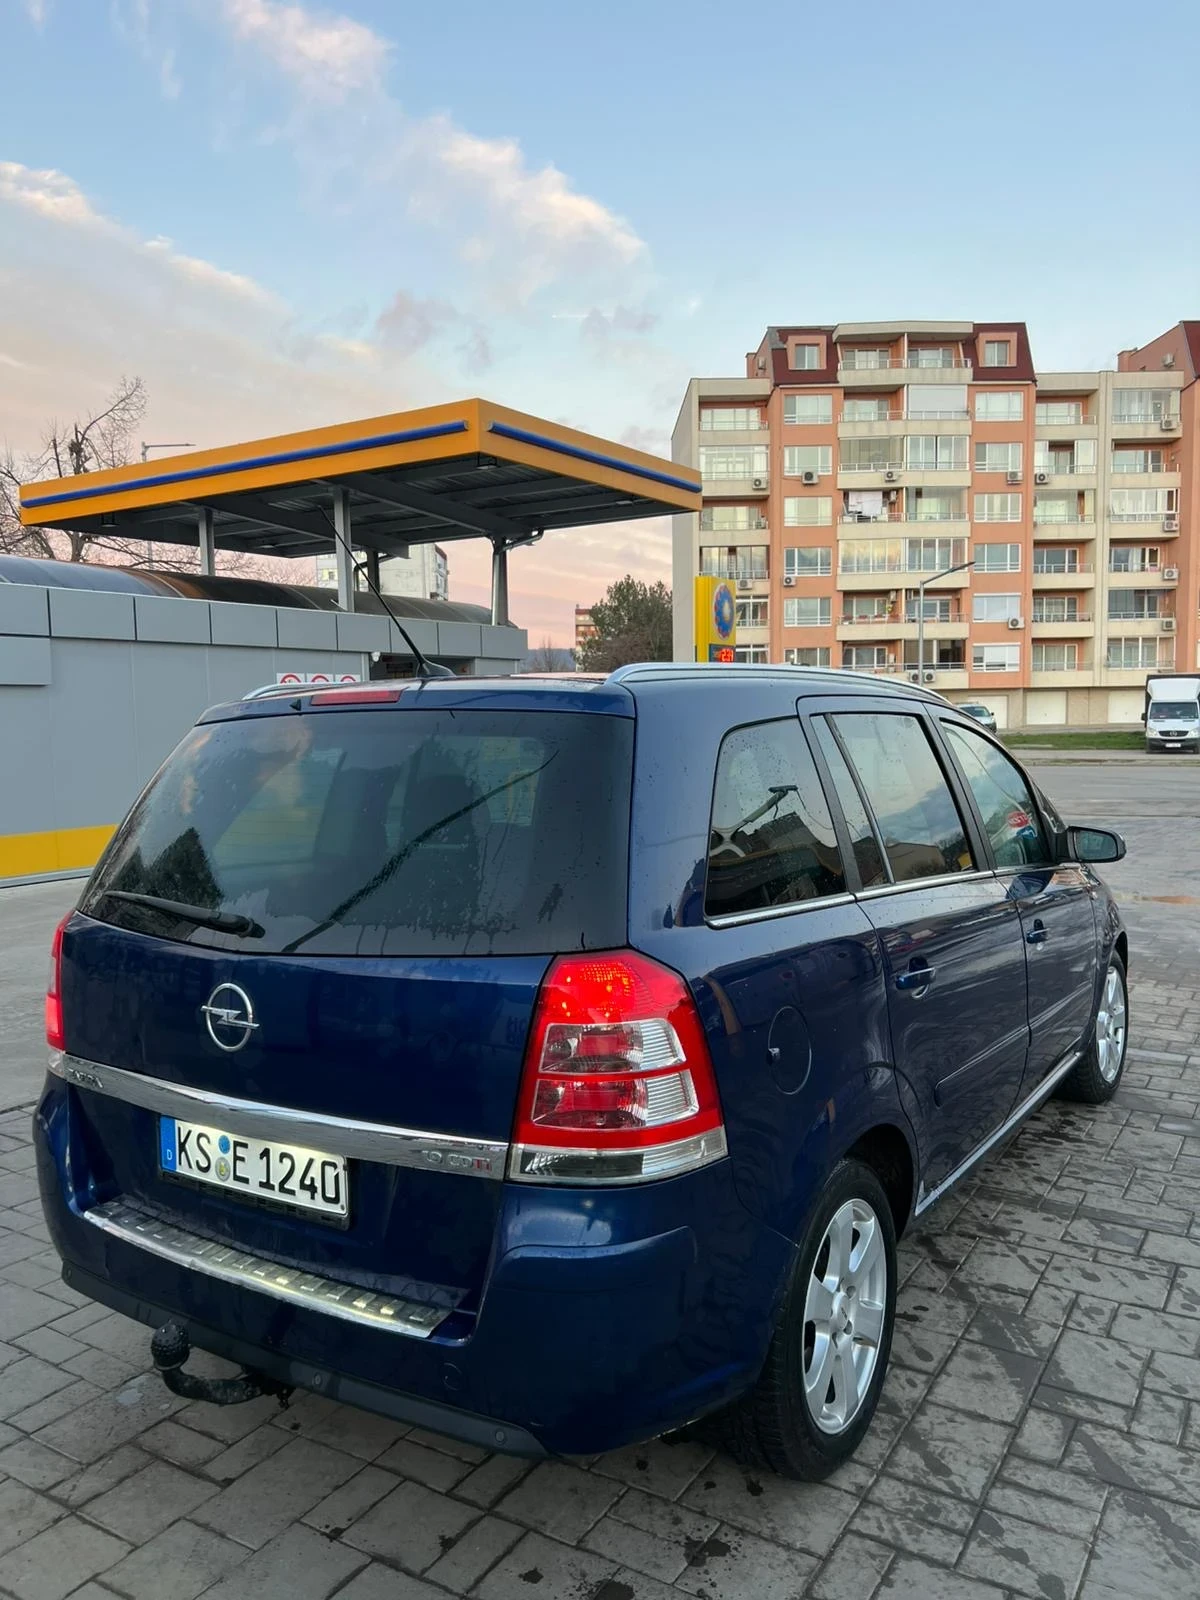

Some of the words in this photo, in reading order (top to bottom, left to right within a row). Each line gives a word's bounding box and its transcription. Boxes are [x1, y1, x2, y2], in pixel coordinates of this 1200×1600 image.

[166, 1149, 173, 1161] D
[177, 1126, 212, 1174] KS
[259, 1147, 341, 1205] 1240
